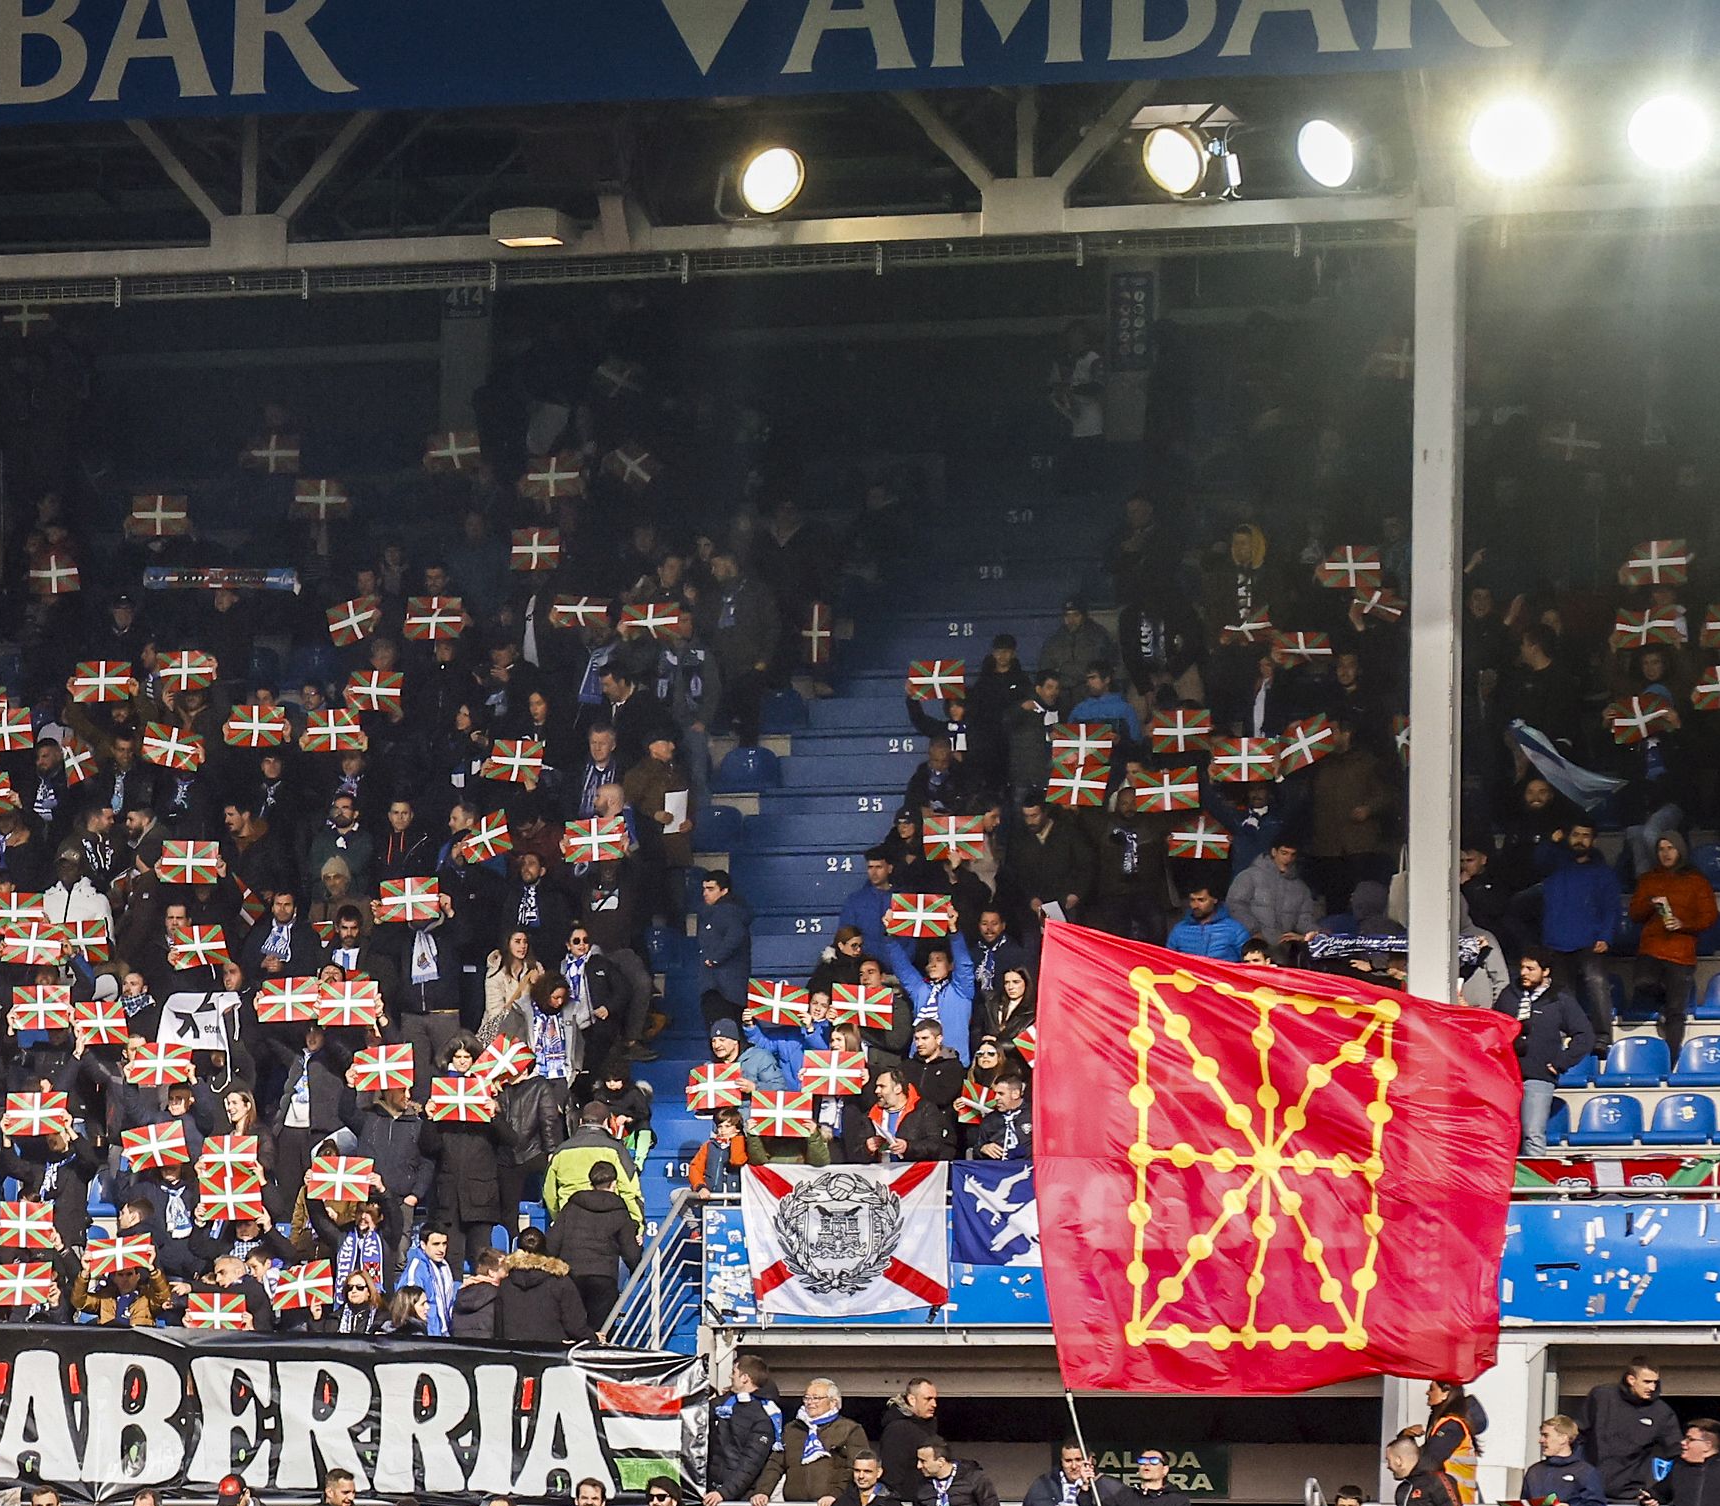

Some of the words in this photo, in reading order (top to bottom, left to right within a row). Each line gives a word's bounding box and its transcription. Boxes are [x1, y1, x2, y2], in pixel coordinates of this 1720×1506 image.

[948, 622, 973, 636] 28
[889, 739, 915, 753] 26
[858, 798, 883, 812] 25
[827, 857, 853, 872] 24
[796, 919, 821, 934] 23
[665, 1162, 690, 1178] 19
